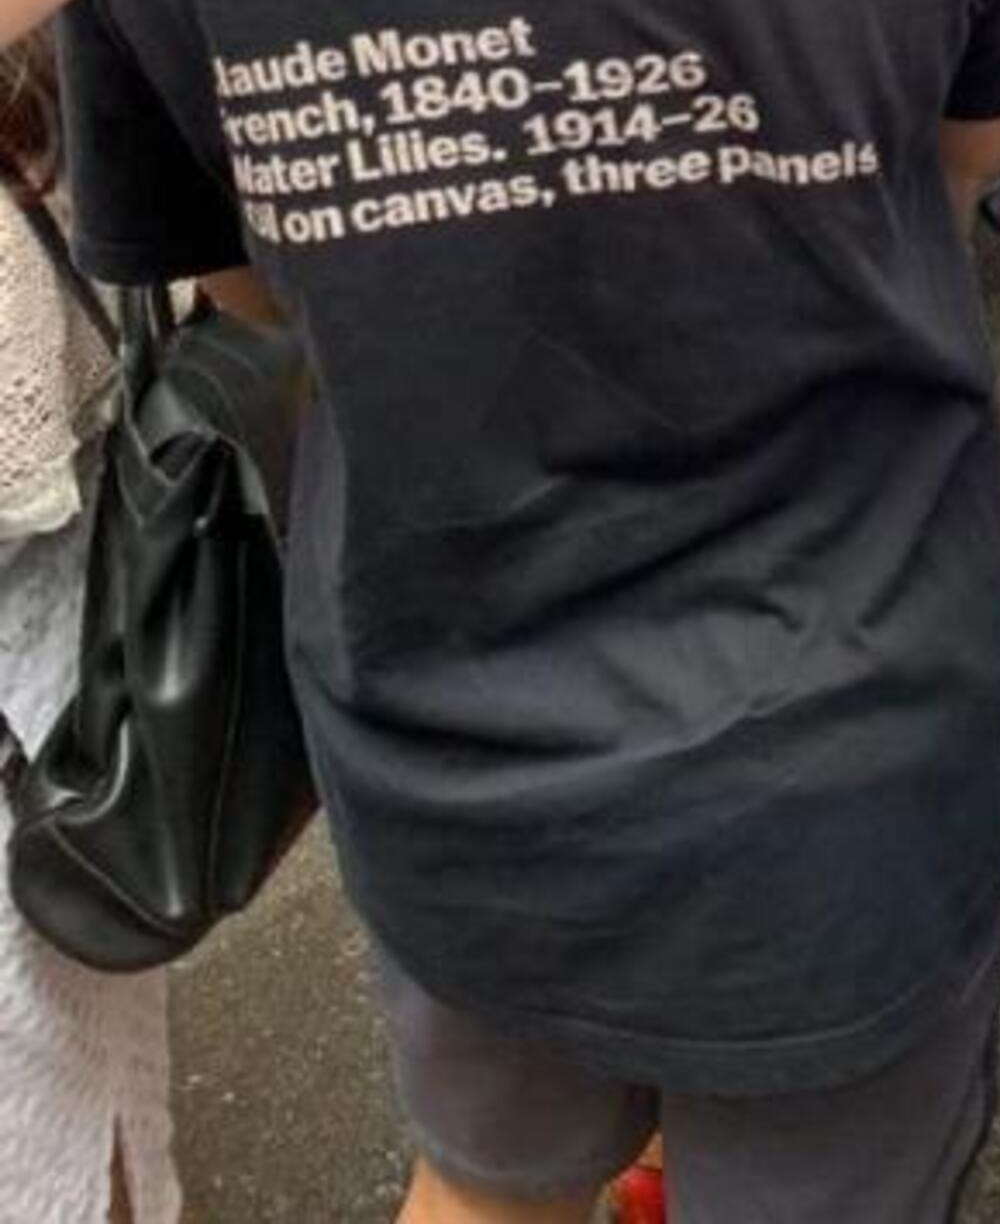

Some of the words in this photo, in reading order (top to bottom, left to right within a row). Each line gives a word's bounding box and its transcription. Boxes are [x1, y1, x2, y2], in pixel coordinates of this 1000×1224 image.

[352, 16, 536, 76] Monet
[220, 91, 375, 146] rench,
[347, 128, 507, 182] Lilies.
[283, 204, 347, 243] on
[352, 175, 557, 232] canvas,
[562, 151, 712, 195] three
[717, 141, 879, 185] panels
